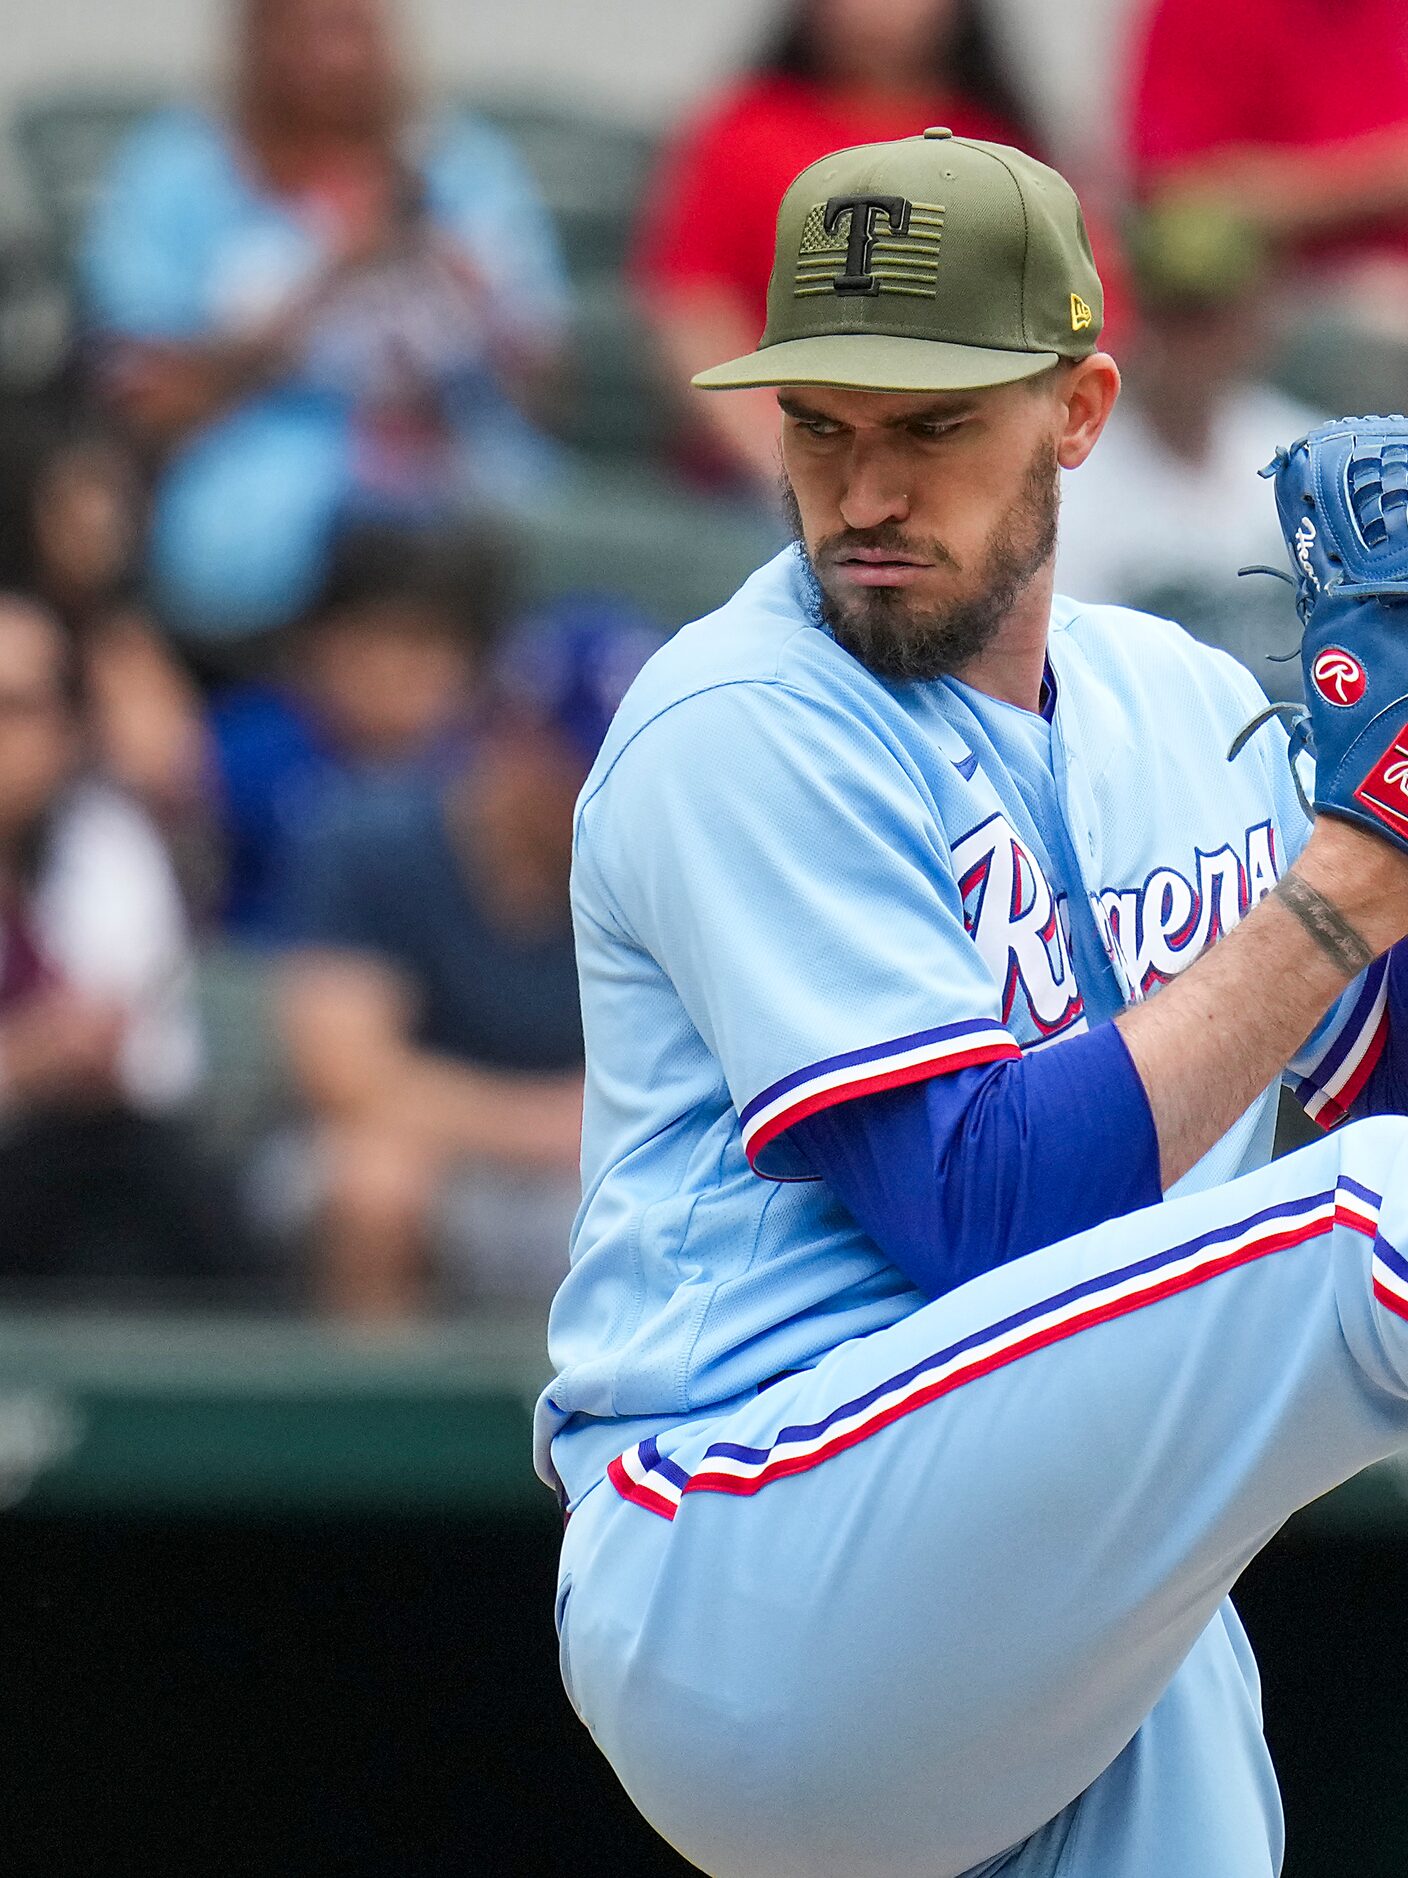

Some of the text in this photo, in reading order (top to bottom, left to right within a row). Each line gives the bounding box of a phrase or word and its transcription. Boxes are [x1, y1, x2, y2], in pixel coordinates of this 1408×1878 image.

[823, 195, 913, 297] T
[1315, 653, 1360, 702] R
[951, 811, 1279, 1037] Rgers
